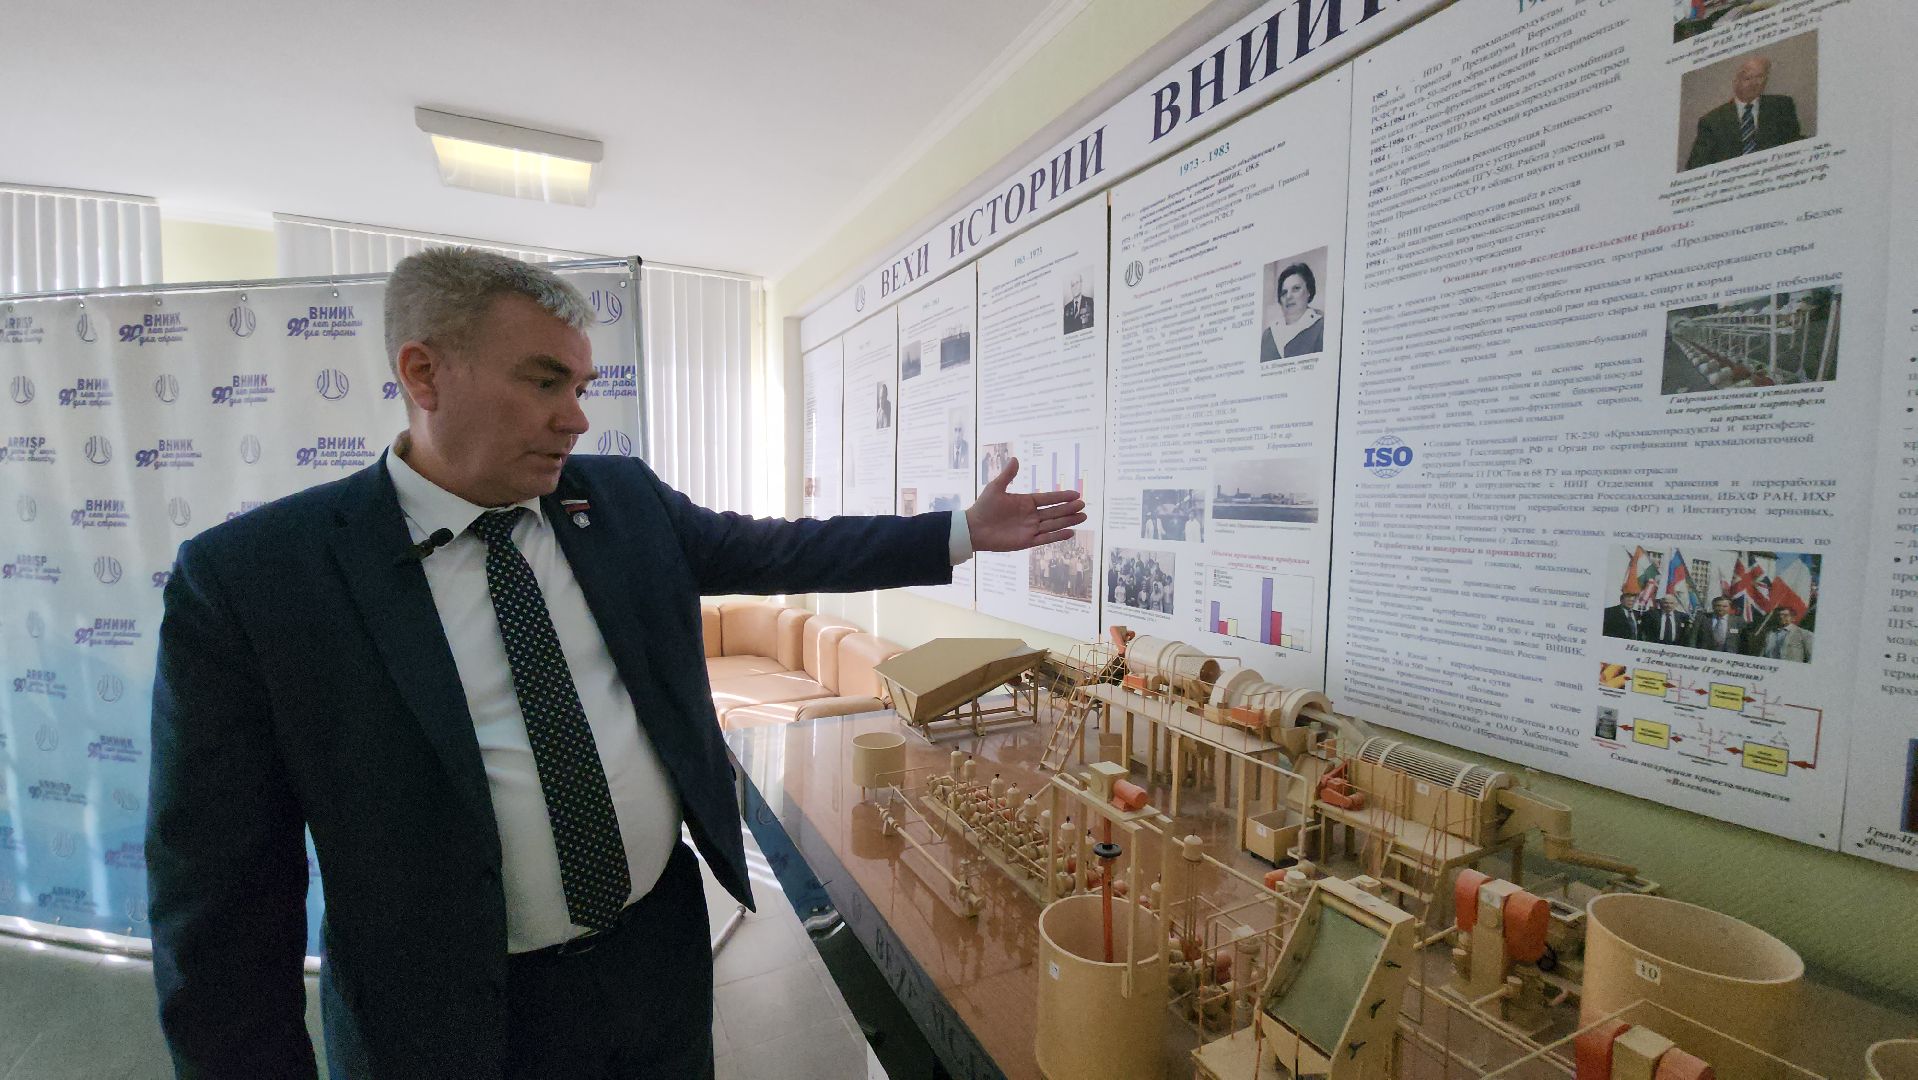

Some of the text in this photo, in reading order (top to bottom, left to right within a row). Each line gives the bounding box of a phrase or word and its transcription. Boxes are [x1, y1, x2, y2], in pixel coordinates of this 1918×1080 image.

[881, 241, 931, 299] ВЕХИ
[949, 125, 1106, 260] ИСТОРИИ
[1149, 0, 1402, 144] ВНИИ
[1178, 155, 1199, 177] 1973
[1207, 139, 1230, 162] 1983
[1640, 216, 1695, 241] работы:
[143, 312, 181, 327] ВНИИК
[309, 306, 355, 320] ВНИИК
[232, 374, 268, 388] ВНИИК
[8, 436, 46, 448] ARRISP
[158, 439, 193, 451] ВНИИК
[317, 436, 366, 450] ВНИИК
[1363, 445, 1413, 468] ISO
[1624, 502, 1660, 515] (ФРГ)
[94, 617, 136, 630] ВНИИК
[1701, 662, 1764, 686] (Германия)
[1641, 963, 1658, 980] 10
